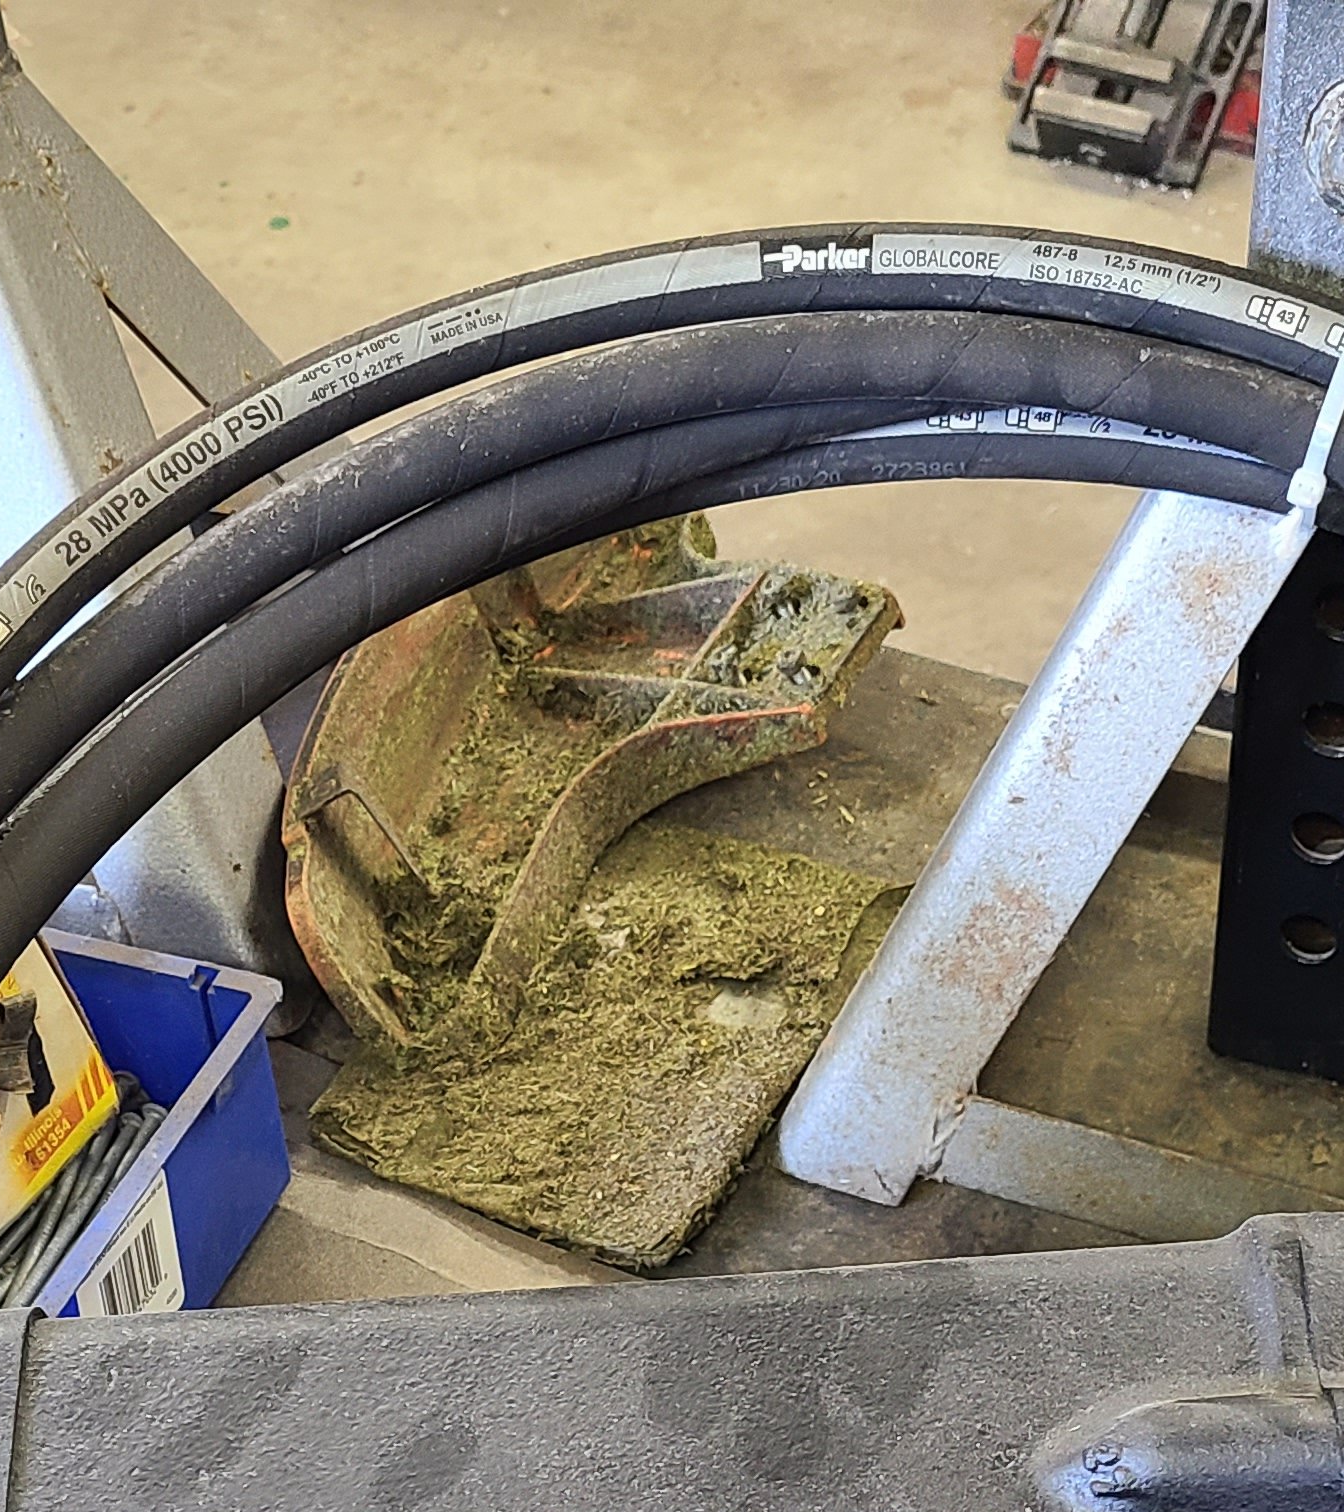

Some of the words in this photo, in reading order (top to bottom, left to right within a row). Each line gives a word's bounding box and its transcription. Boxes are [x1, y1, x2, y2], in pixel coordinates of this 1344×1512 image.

[763, 242, 870, 273] Parker
[878, 249, 1002, 271] GLOBALCORE
[1032, 244, 1079, 262] 487-8
[1103, 252, 1137, 274] 12,5
[1141, 261, 1173, 279] mm
[1176, 268, 1222, 294] (1/2")
[1028, 263, 1060, 282] ISO
[1064, 268, 1143, 295] 18752-AC
[429, 325, 464, 345] MADE
[465, 320, 479, 333] IN
[479, 311, 504, 328] USA
[1276, 308, 1295, 326] 43
[333, 352, 353, 368] TO
[339, 371, 360, 388] TO
[54, 529, 93, 568] 28
[87, 486, 152, 539] MPa
[146, 430, 223, 495] (4000
[222, 392, 285, 445] PSI)
[35, 1117, 72, 1161] 61354
